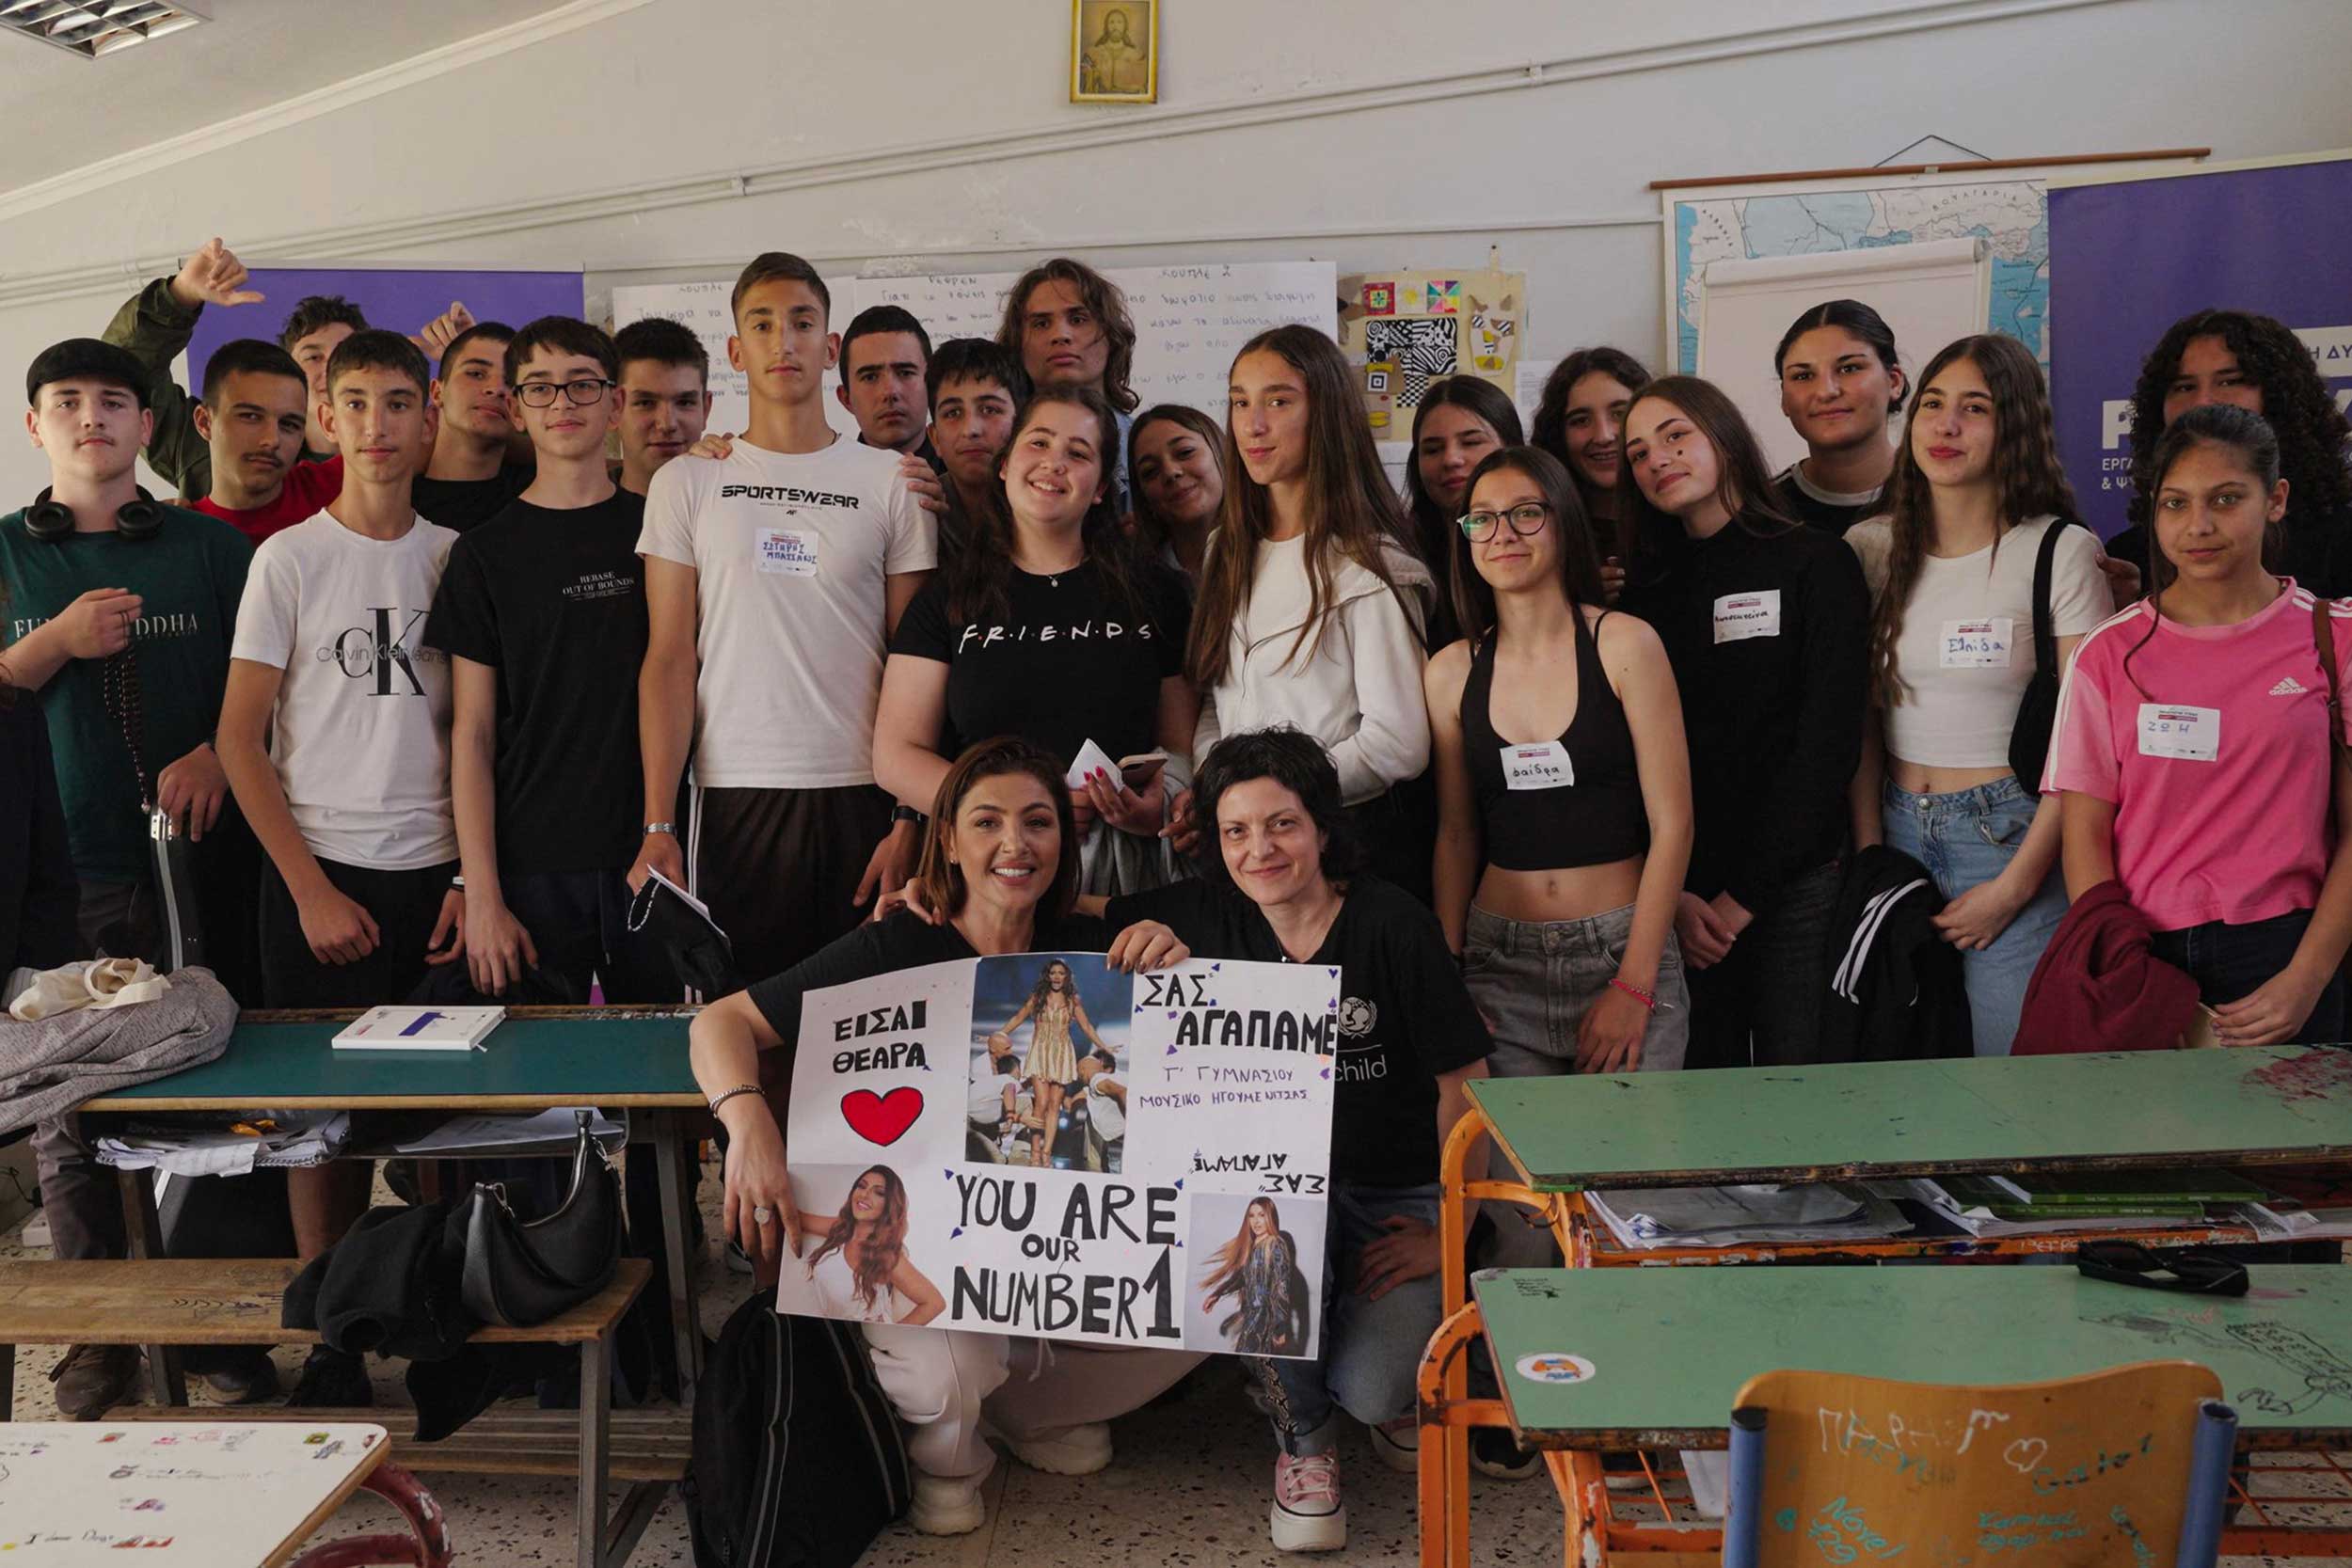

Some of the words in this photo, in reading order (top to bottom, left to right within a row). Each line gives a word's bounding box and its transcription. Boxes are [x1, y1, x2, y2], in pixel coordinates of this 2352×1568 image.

[2102, 476, 2112, 490] &
[722, 484, 859, 510] SPORTSWEAR
[563, 585, 581, 595] OUT
[583, 583, 595, 592] OF
[597, 577, 634, 590] BOUNDS
[580, 571, 615, 584] REBASE
[135, 612, 199, 637] DDHA
[2268, 687, 2309, 696] adidas
[1142, 974, 1209, 1007] ΣΑΣ
[834, 1000, 927, 1042] ΕΙΣΑΙ
[1176, 1009, 1337, 1056] ΑΓΑΠΑΜΕ
[833, 1041, 927, 1074] ΘΕΑΡΑ
[1198, 1066, 1294, 1084] ΓΥΜΝΑΣΙΟΥ
[1140, 1093, 1201, 1109] ΜΟΥΣΙΚΟ
[956, 1174, 1037, 1232] YOU
[1060, 1181, 1179, 1244] ARE
[1021, 1233, 1081, 1262] OUR
